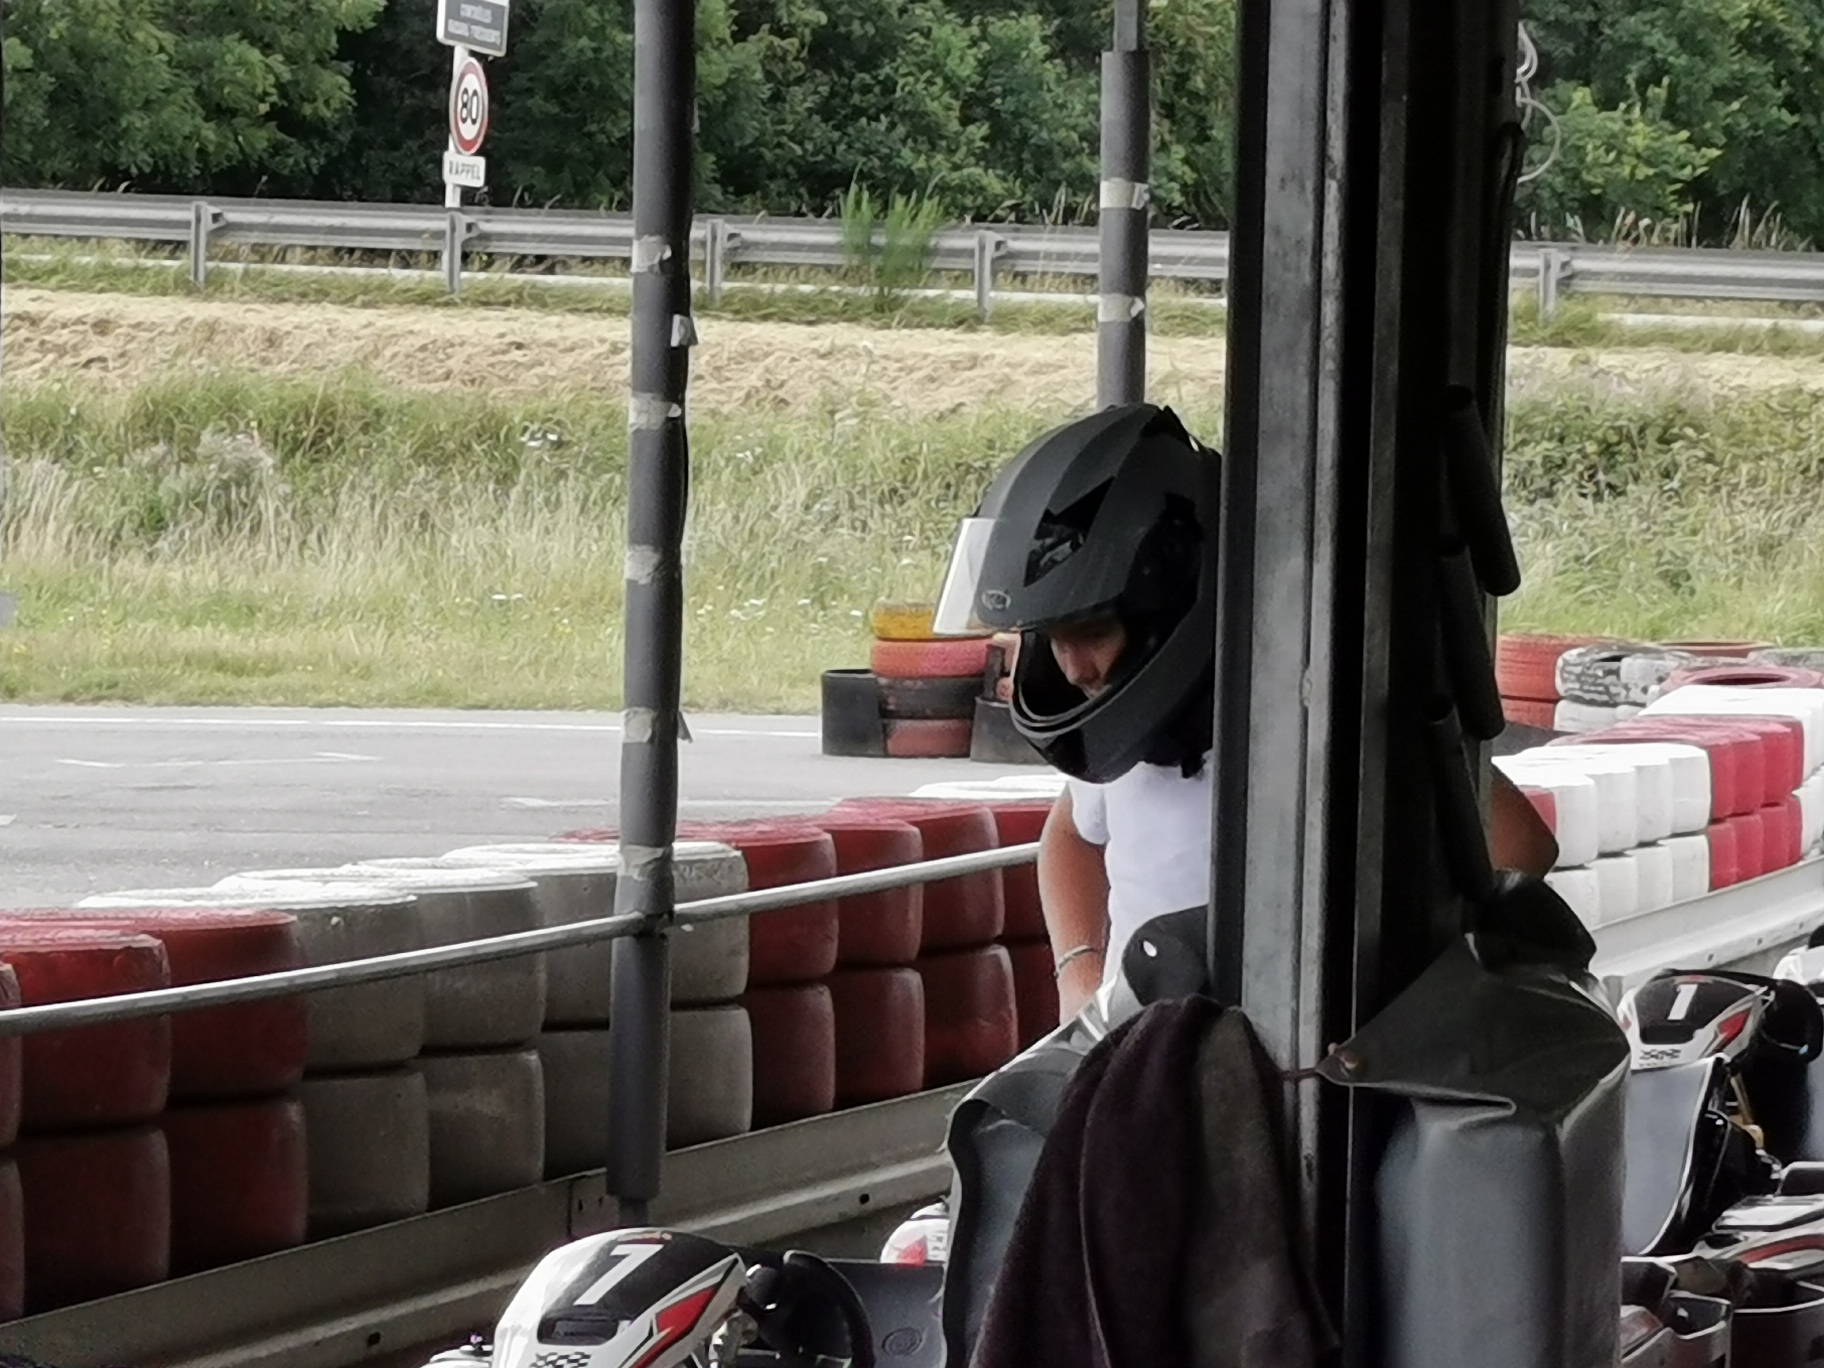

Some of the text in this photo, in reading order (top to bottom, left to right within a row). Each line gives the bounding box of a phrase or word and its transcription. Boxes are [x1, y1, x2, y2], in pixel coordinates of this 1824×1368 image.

[459, 87, 481, 126] 80
[448, 160, 482, 181] RAPPEL
[1666, 983, 1699, 1021] 1
[572, 1243, 665, 1306] 7
